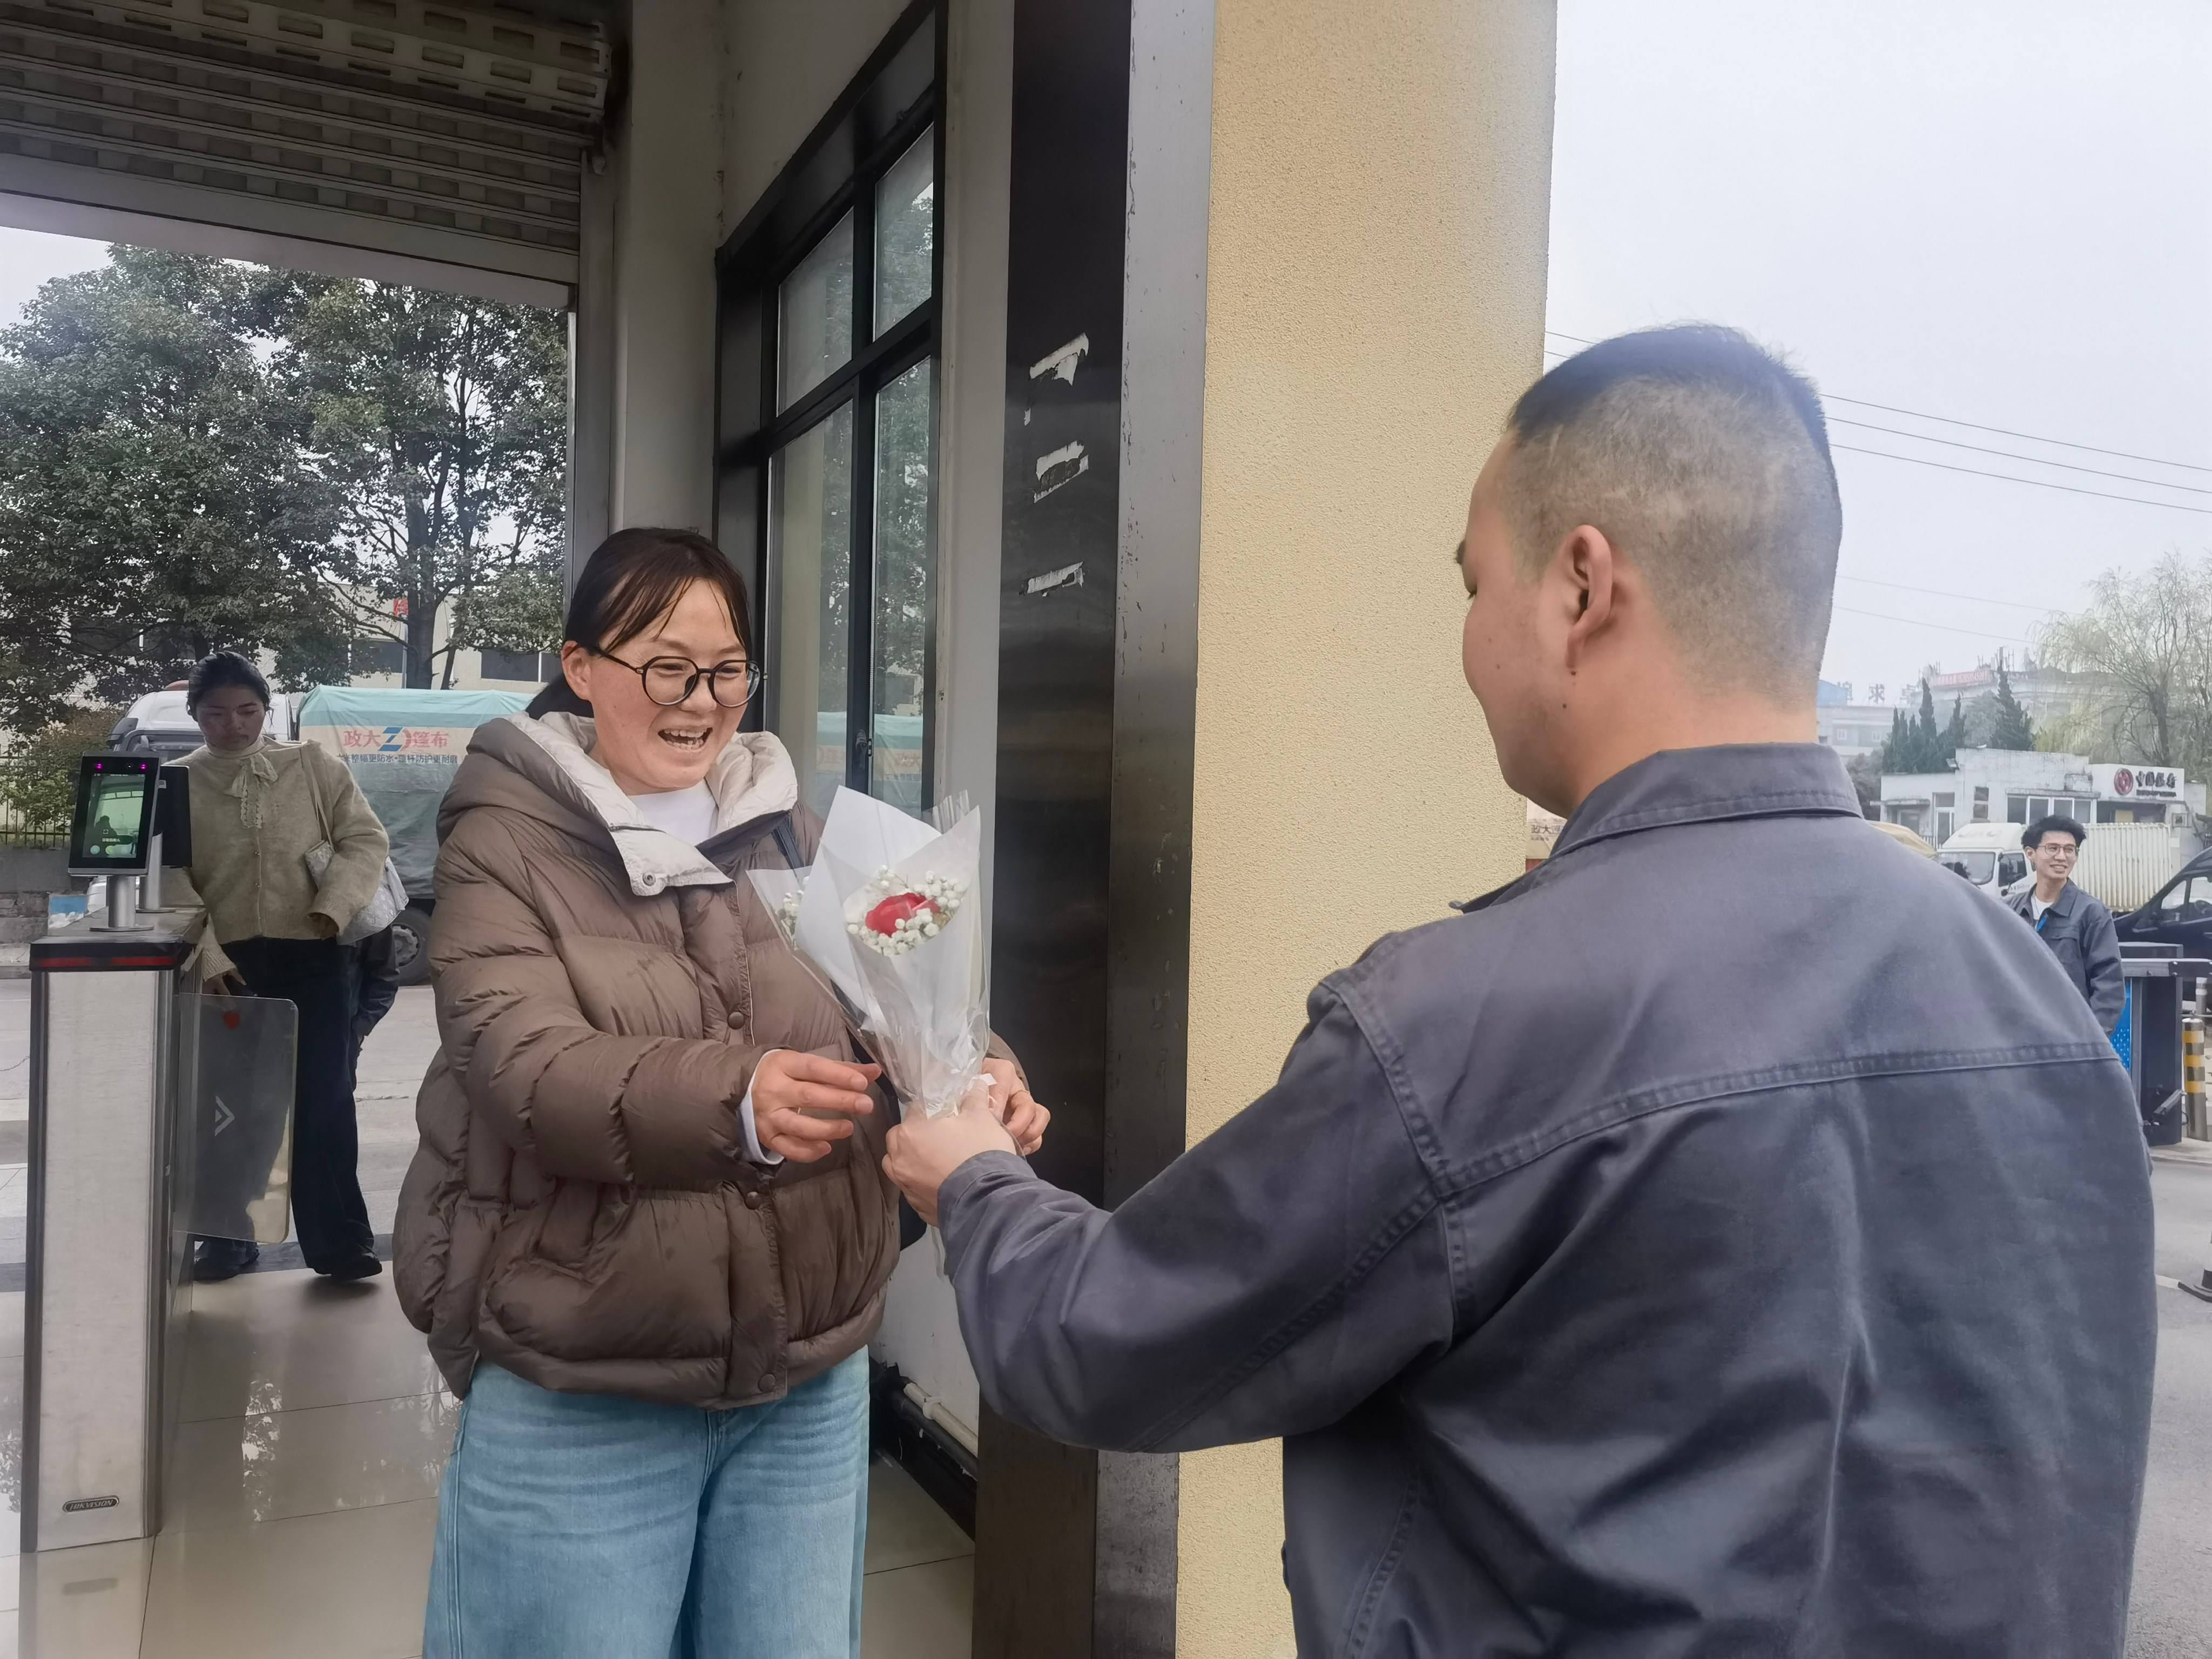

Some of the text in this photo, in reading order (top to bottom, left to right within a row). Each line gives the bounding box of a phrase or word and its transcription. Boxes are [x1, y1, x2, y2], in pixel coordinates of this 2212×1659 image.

[343, 730, 381, 747] 政大
[412, 731, 449, 748] 篷布
[69, 1499, 113, 1510] HIKVISION
